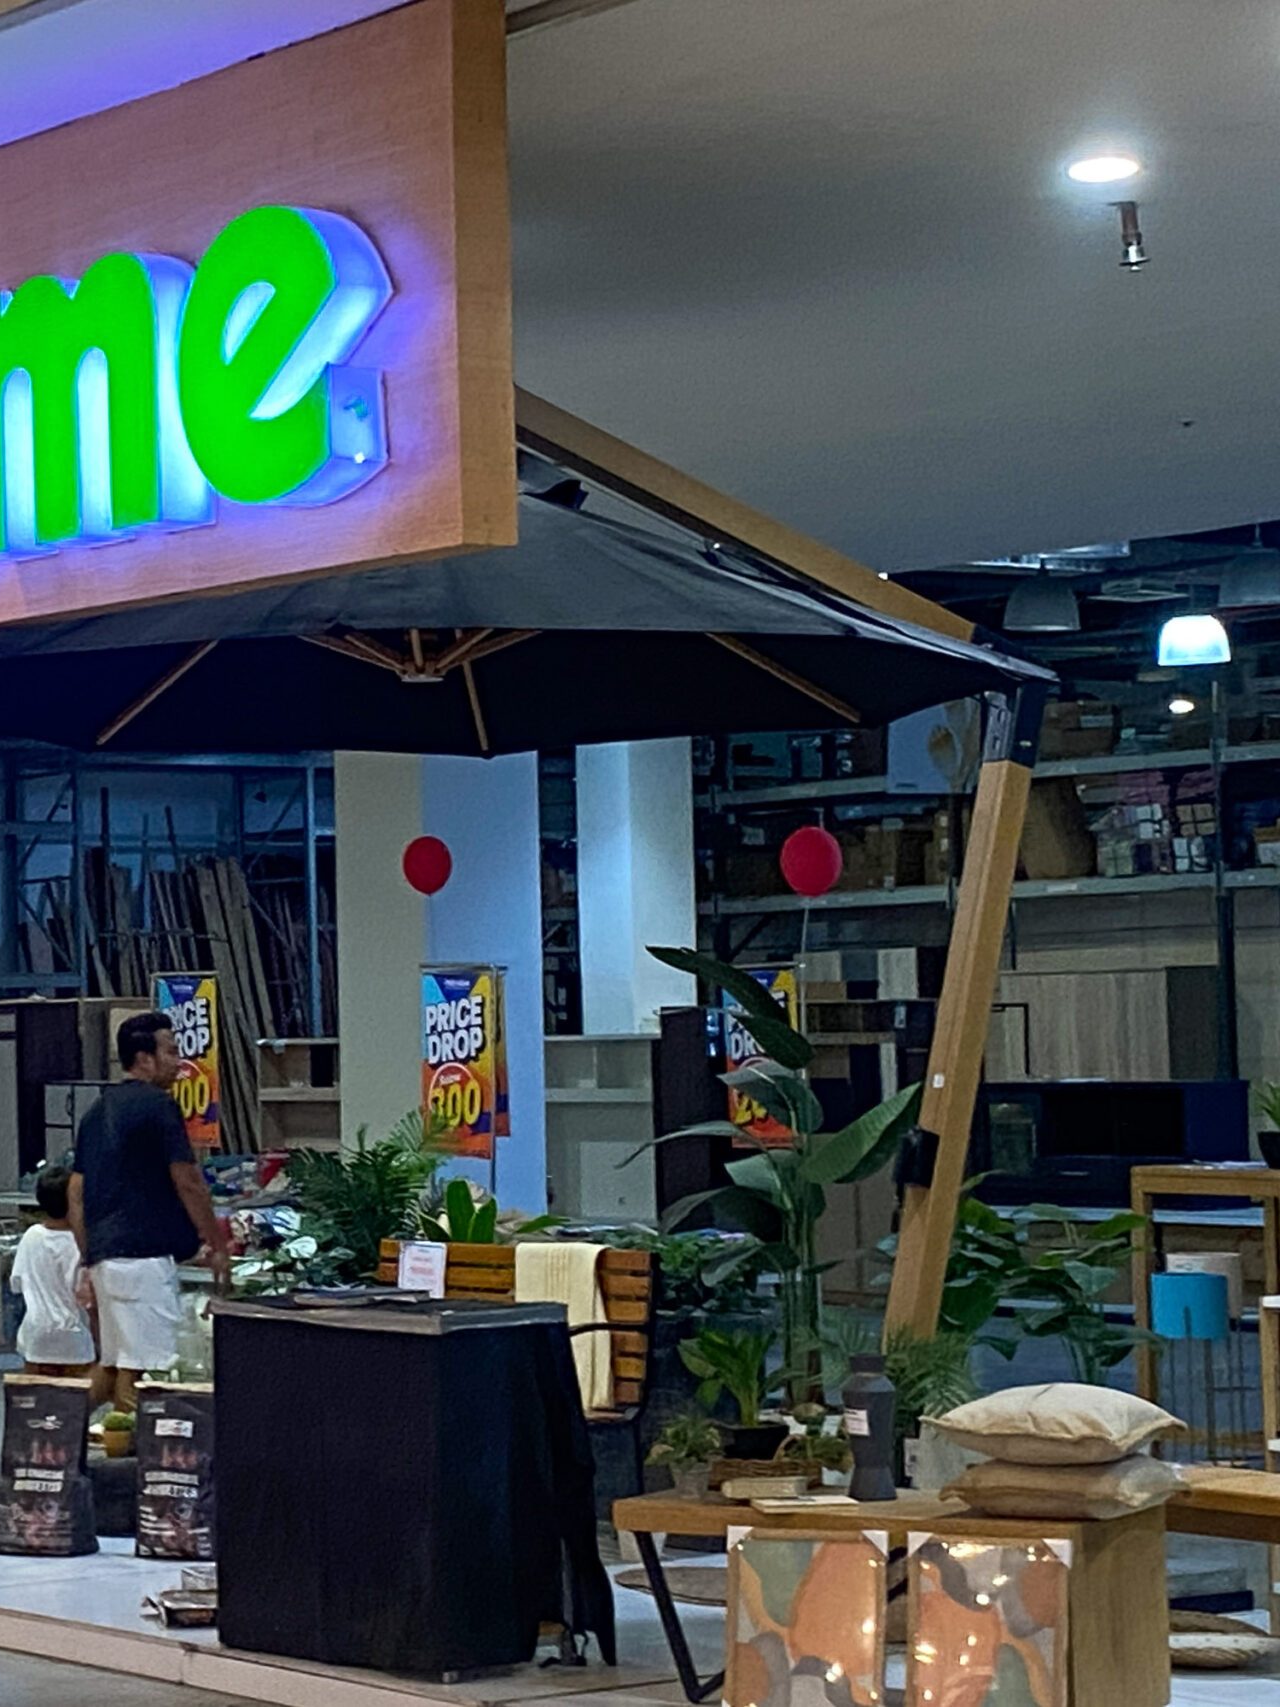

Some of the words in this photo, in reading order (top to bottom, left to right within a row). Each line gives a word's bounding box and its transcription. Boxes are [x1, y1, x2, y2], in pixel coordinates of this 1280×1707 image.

[426, 995, 483, 1035] PRICE
[175, 1026, 210, 1058] ROP
[428, 1027, 484, 1065] DROP
[172, 1073, 210, 1119] 00
